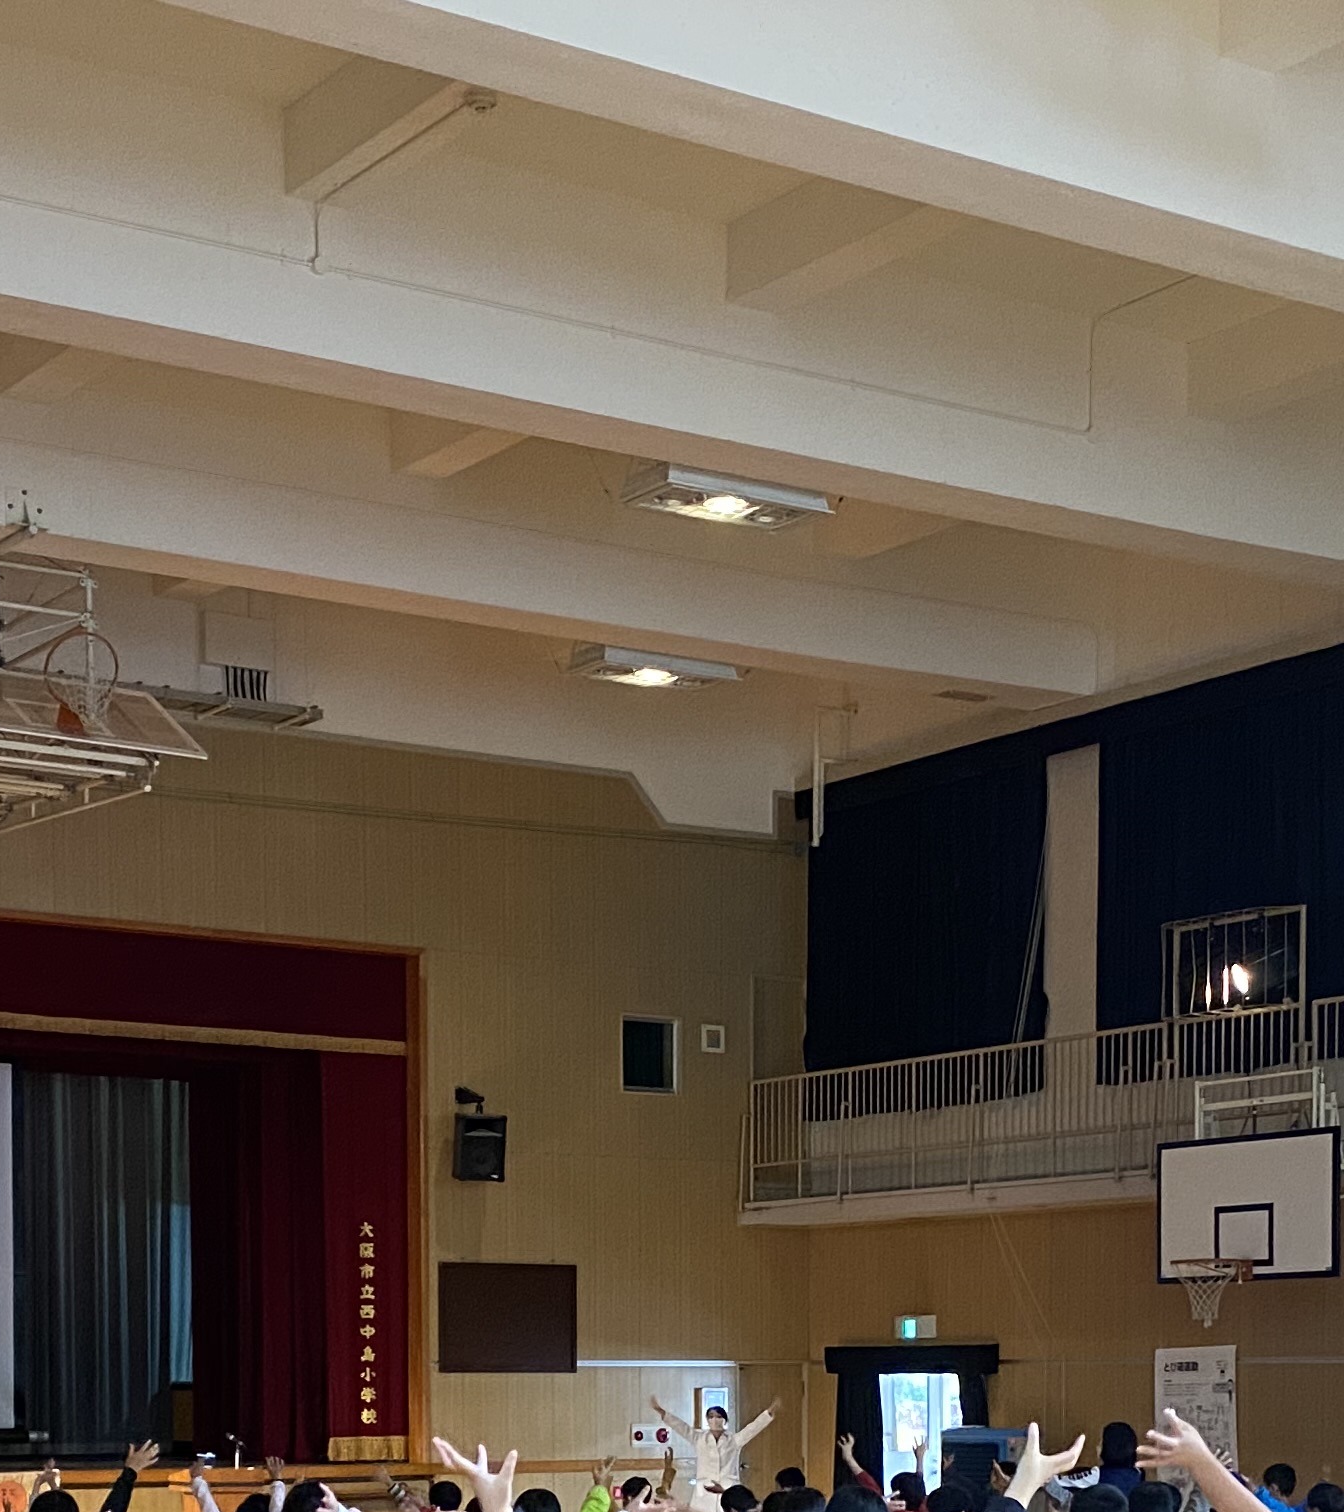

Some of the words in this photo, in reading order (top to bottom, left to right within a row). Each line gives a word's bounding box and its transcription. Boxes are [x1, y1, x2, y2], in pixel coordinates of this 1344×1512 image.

[358, 1221, 378, 1425] 大阪市立西中島小学校
